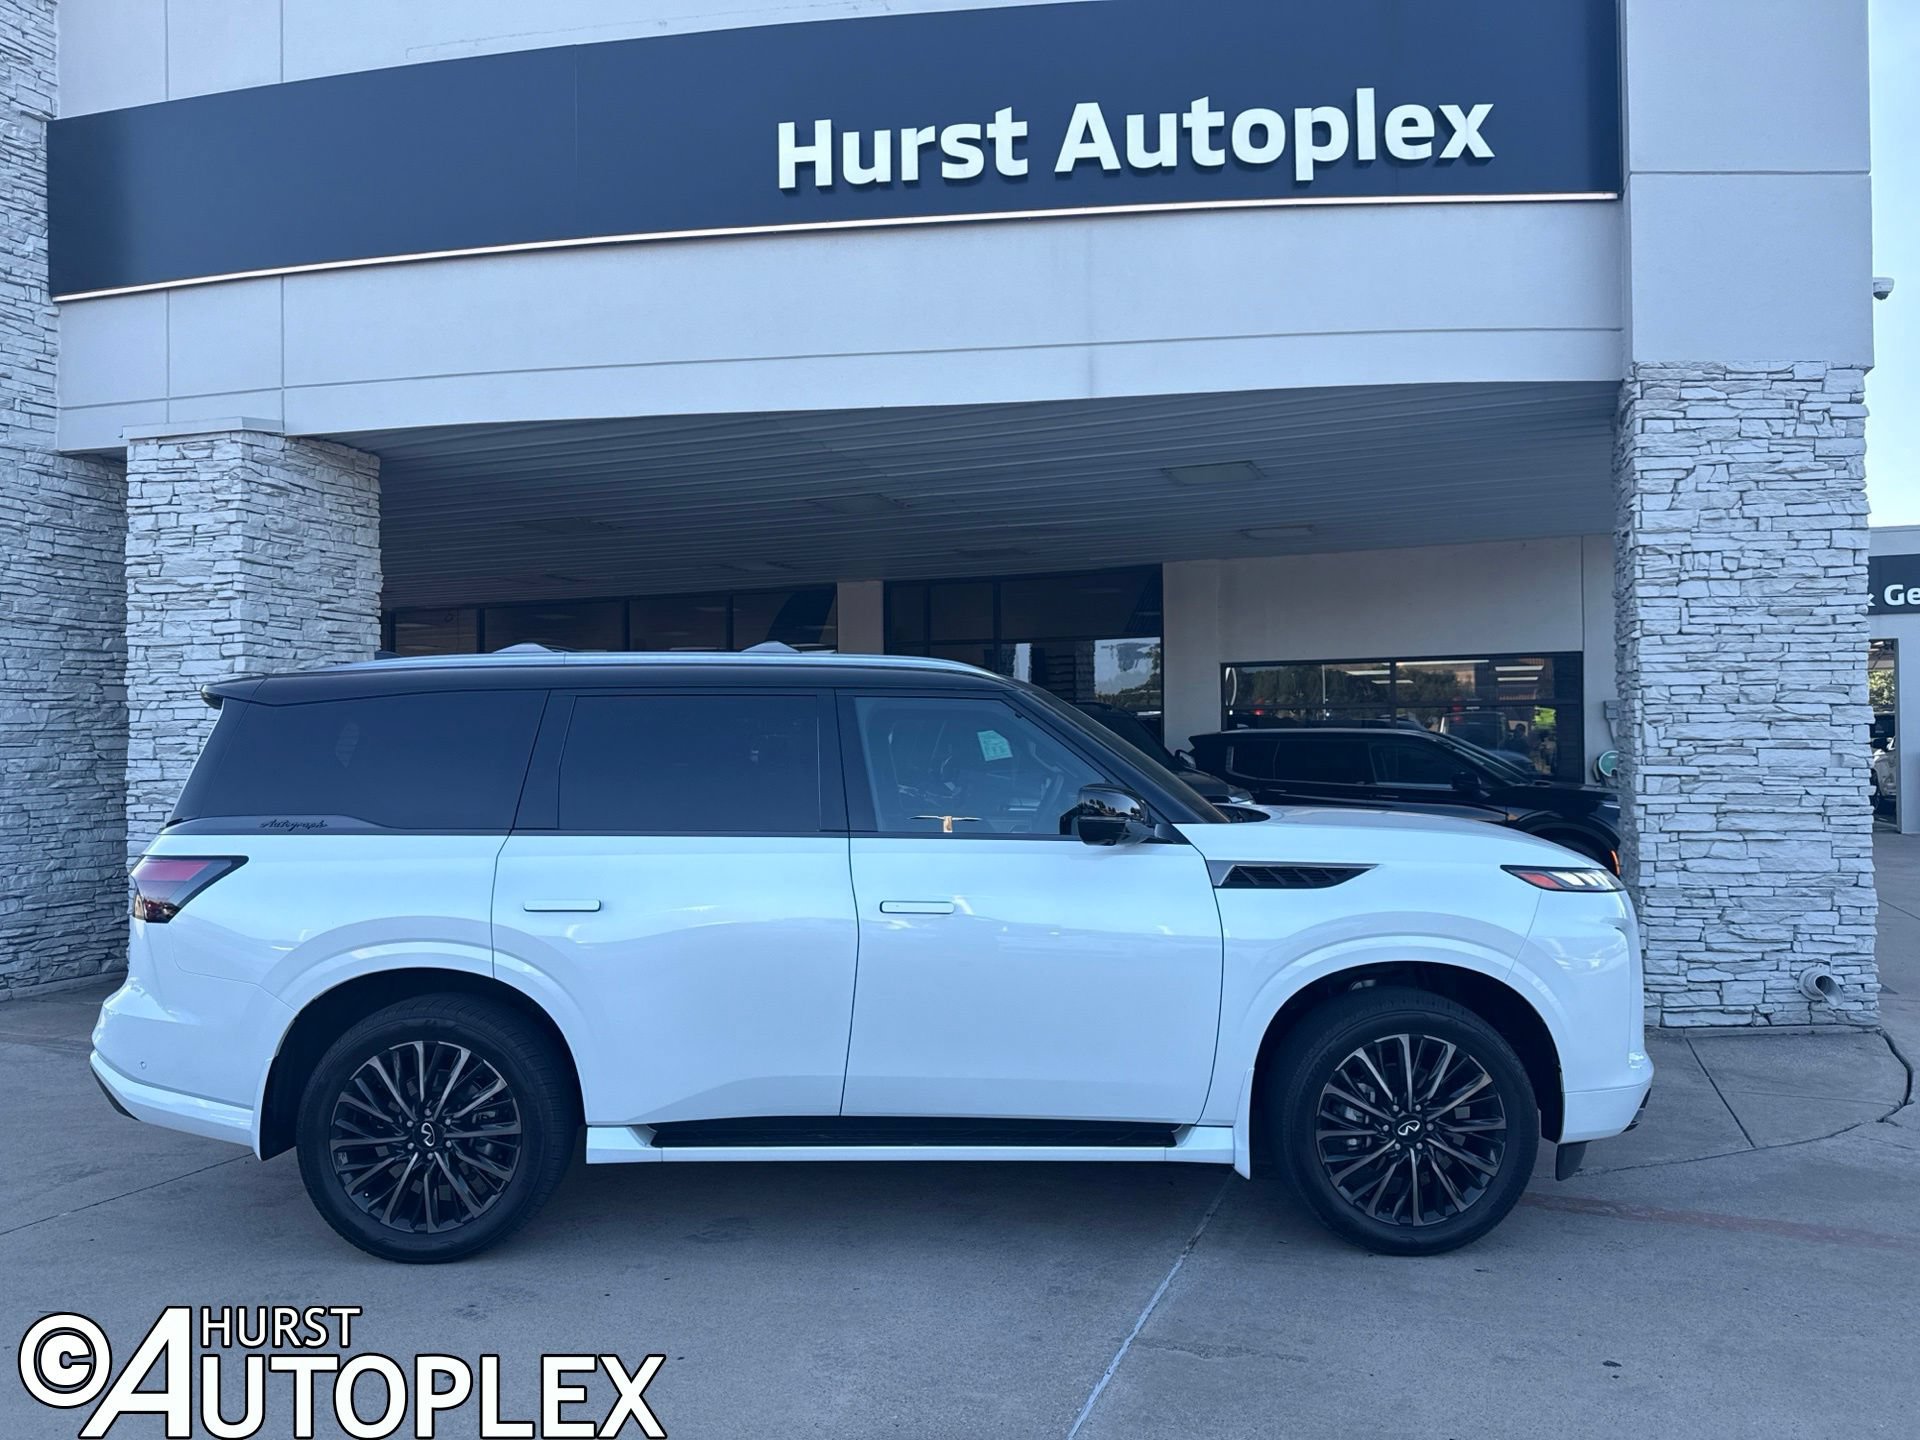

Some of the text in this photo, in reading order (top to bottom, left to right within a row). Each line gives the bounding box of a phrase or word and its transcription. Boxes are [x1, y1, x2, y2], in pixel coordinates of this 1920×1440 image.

[778, 87, 1495, 189] Hurst Autoplex
[1884, 583, 1920, 606] Ge
[259, 819, 328, 832] Autograph
